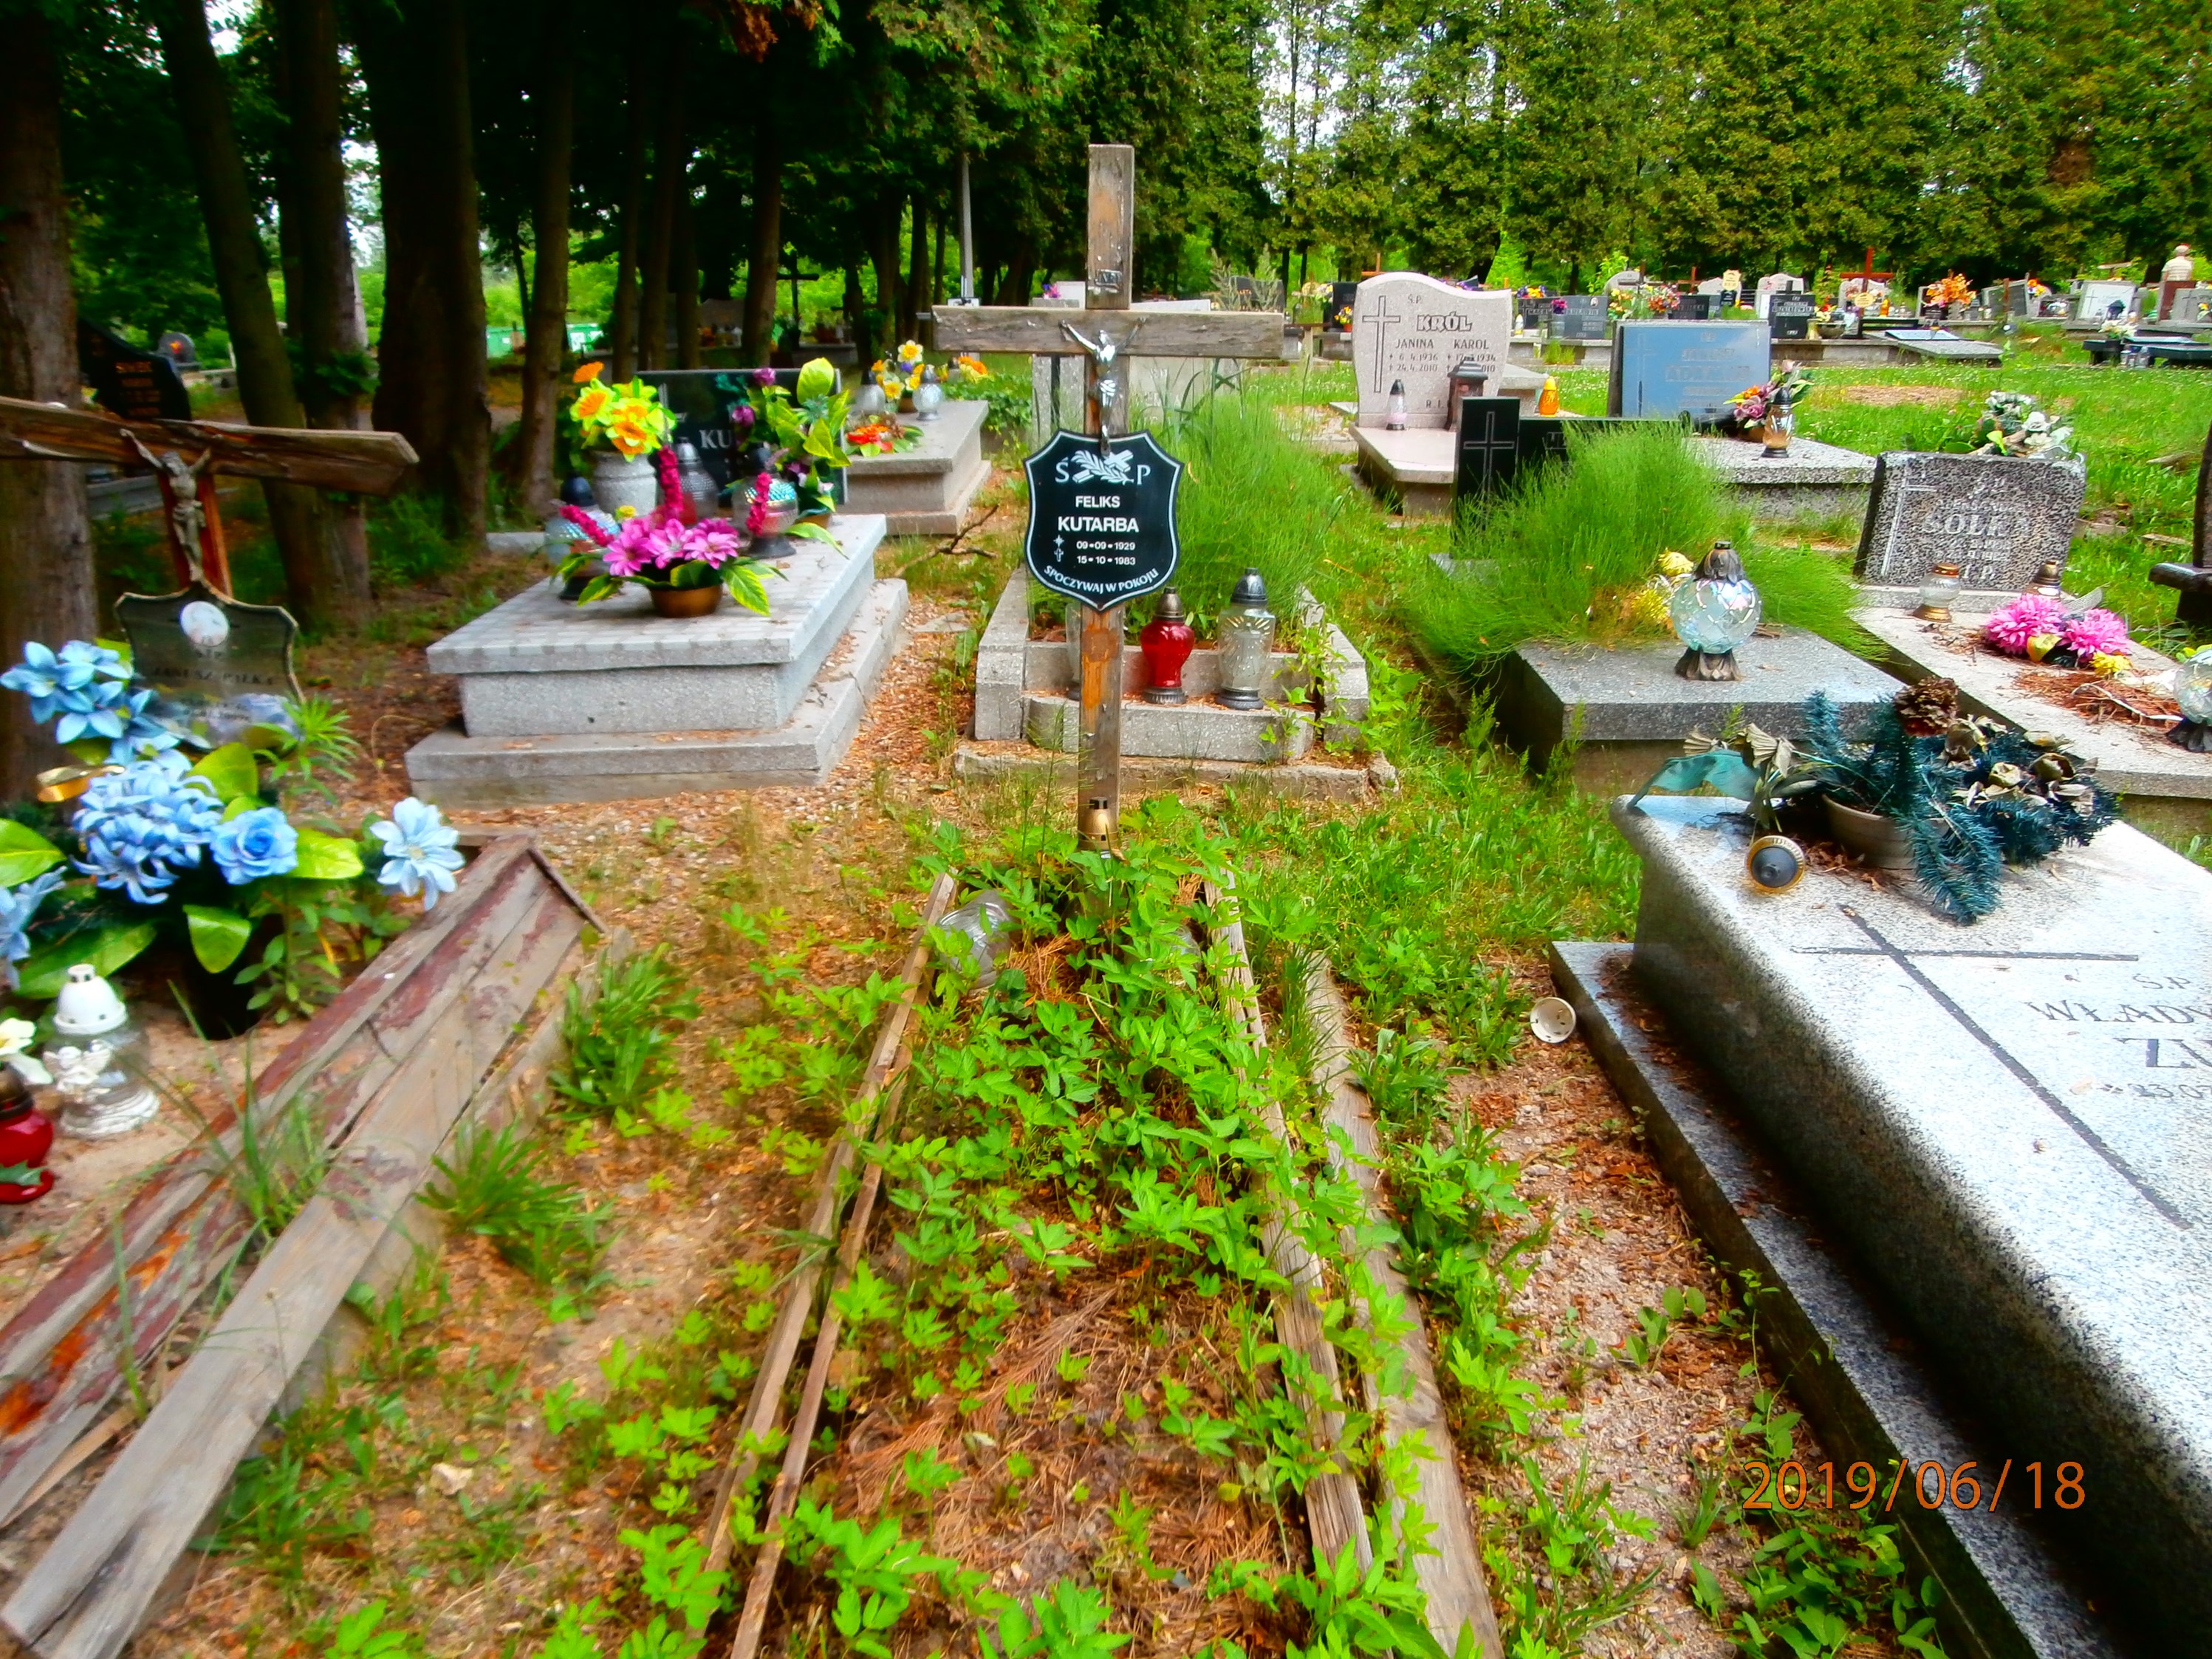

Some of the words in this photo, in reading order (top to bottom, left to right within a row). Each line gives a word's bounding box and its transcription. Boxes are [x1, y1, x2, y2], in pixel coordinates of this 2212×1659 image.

[1417, 311, 1473, 332] KRÓL
[1395, 338, 1434, 349] JANINA
[1453, 338, 1490, 349] KAROL
[1137, 464, 1151, 485] P
[1075, 495, 1121, 509] FELIKS
[1058, 516, 1140, 533] KUTARBA
[1044, 565, 1103, 594] SPOCZYWAJ
[1105, 584, 1117, 592] W
[1117, 567, 1160, 592] POKOJU
